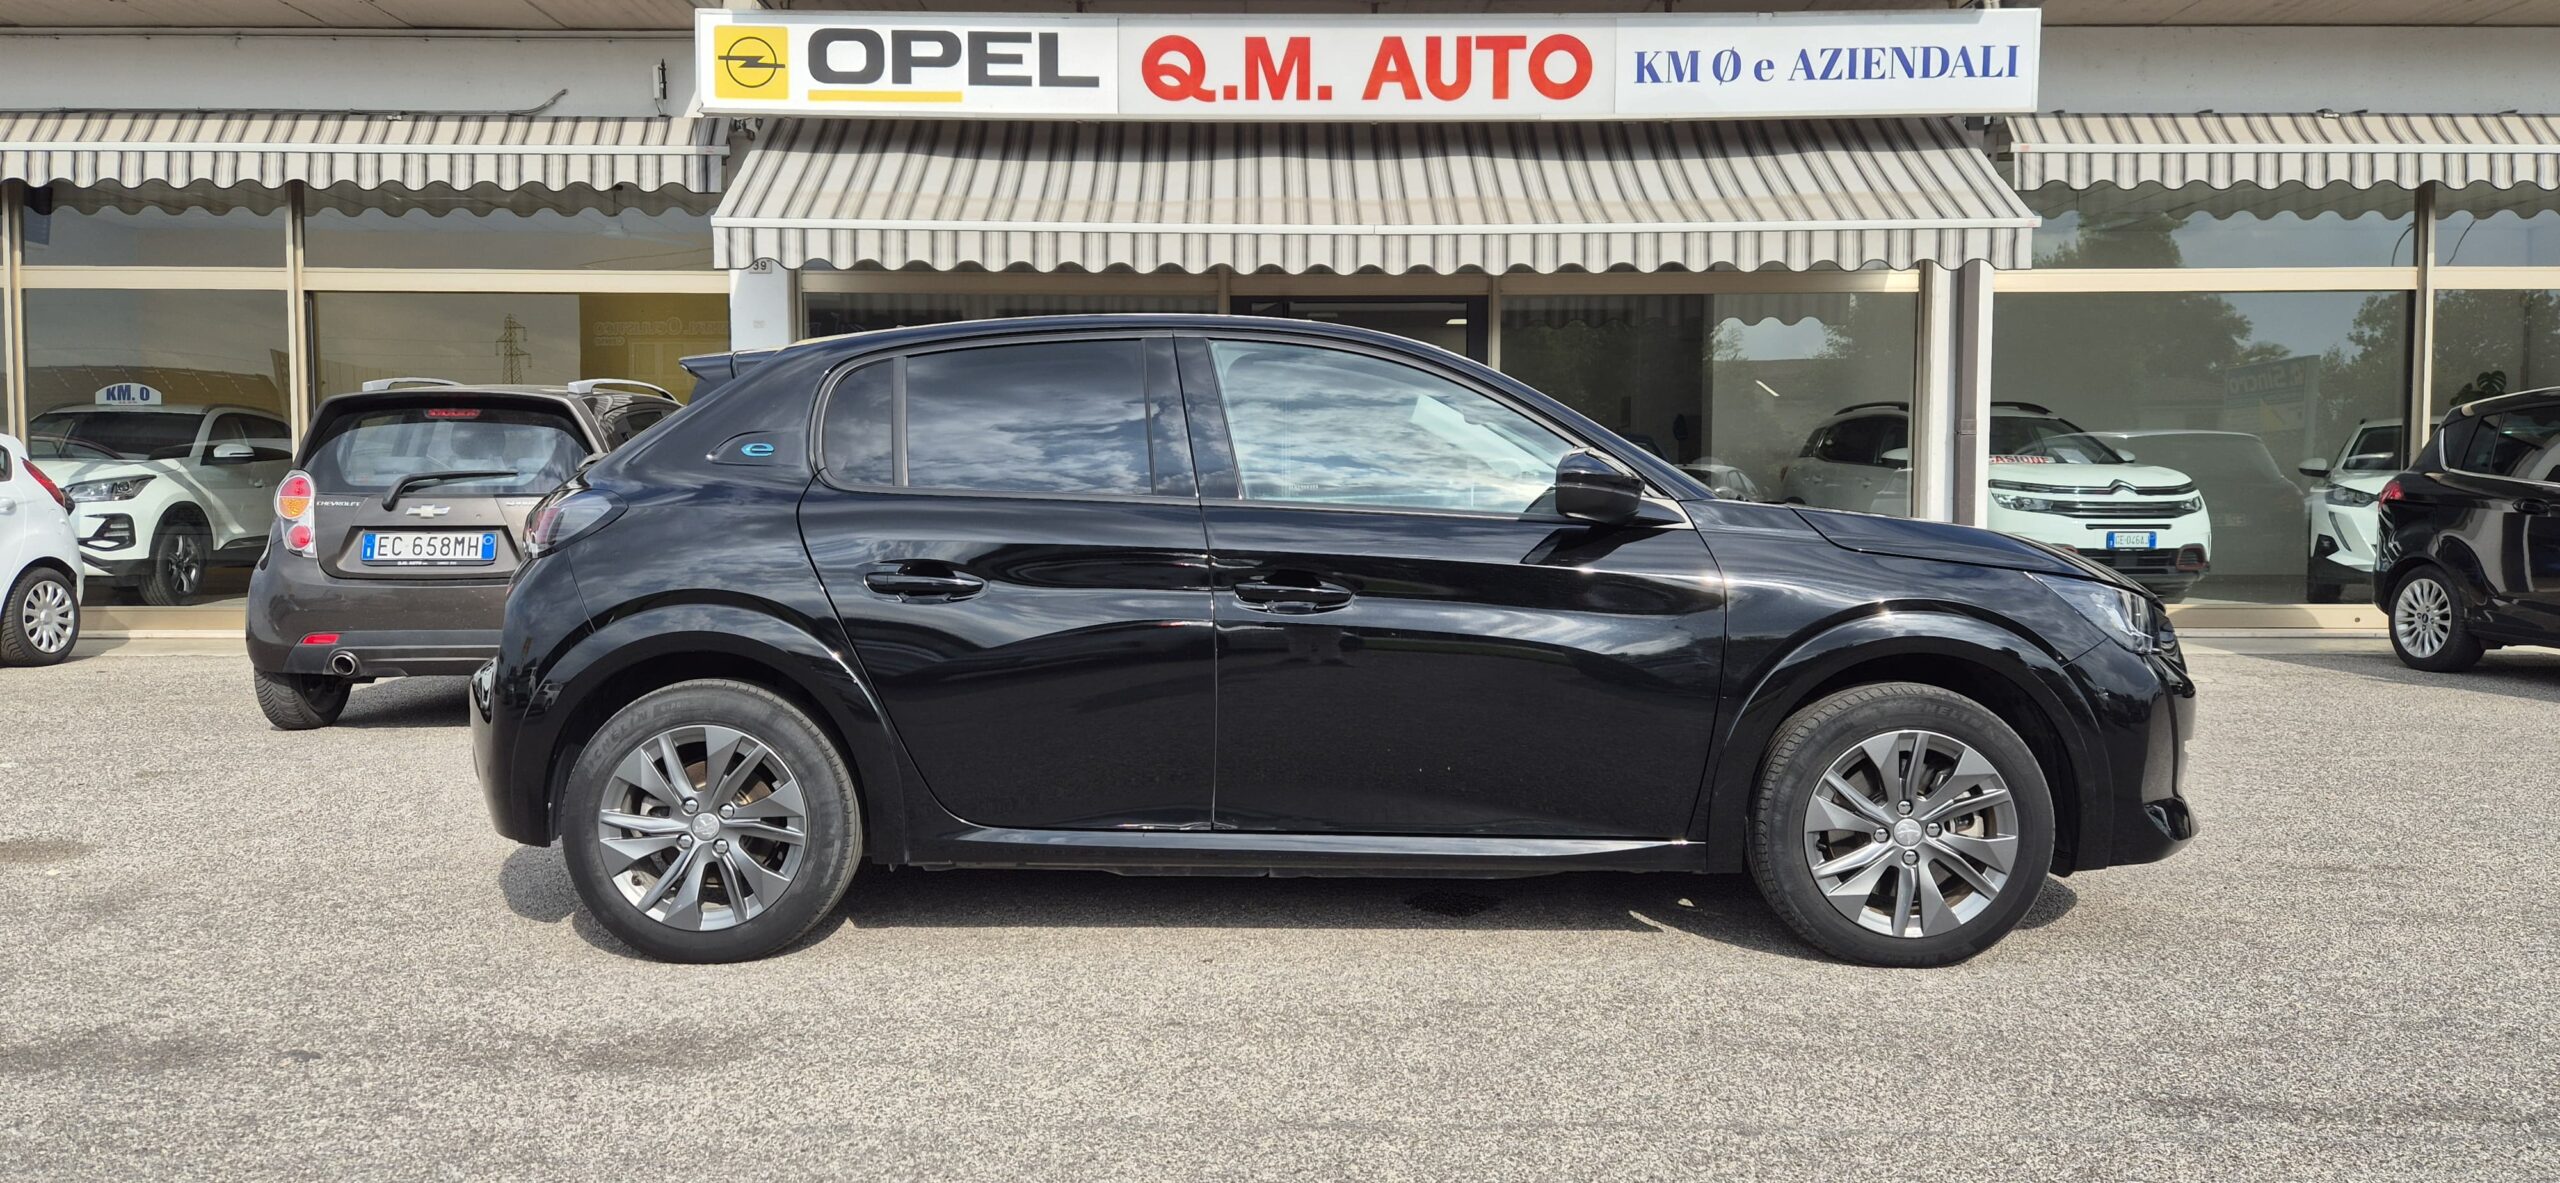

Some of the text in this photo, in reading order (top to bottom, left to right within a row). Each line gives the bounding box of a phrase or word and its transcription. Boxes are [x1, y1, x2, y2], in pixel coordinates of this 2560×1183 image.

[808, 27, 1100, 88] OPEL
[1141, 33, 1593, 102] Q.M. AUTO
[1634, 50, 1701, 84] KM
[1753, 56, 1775, 82] e
[1787, 45, 2021, 82] AZIENDALI
[106, 384, 136, 401] KM.
[741, 443, 774, 457] e
[377, 536, 403, 556] EC
[412, 536, 480, 556] 658MH
